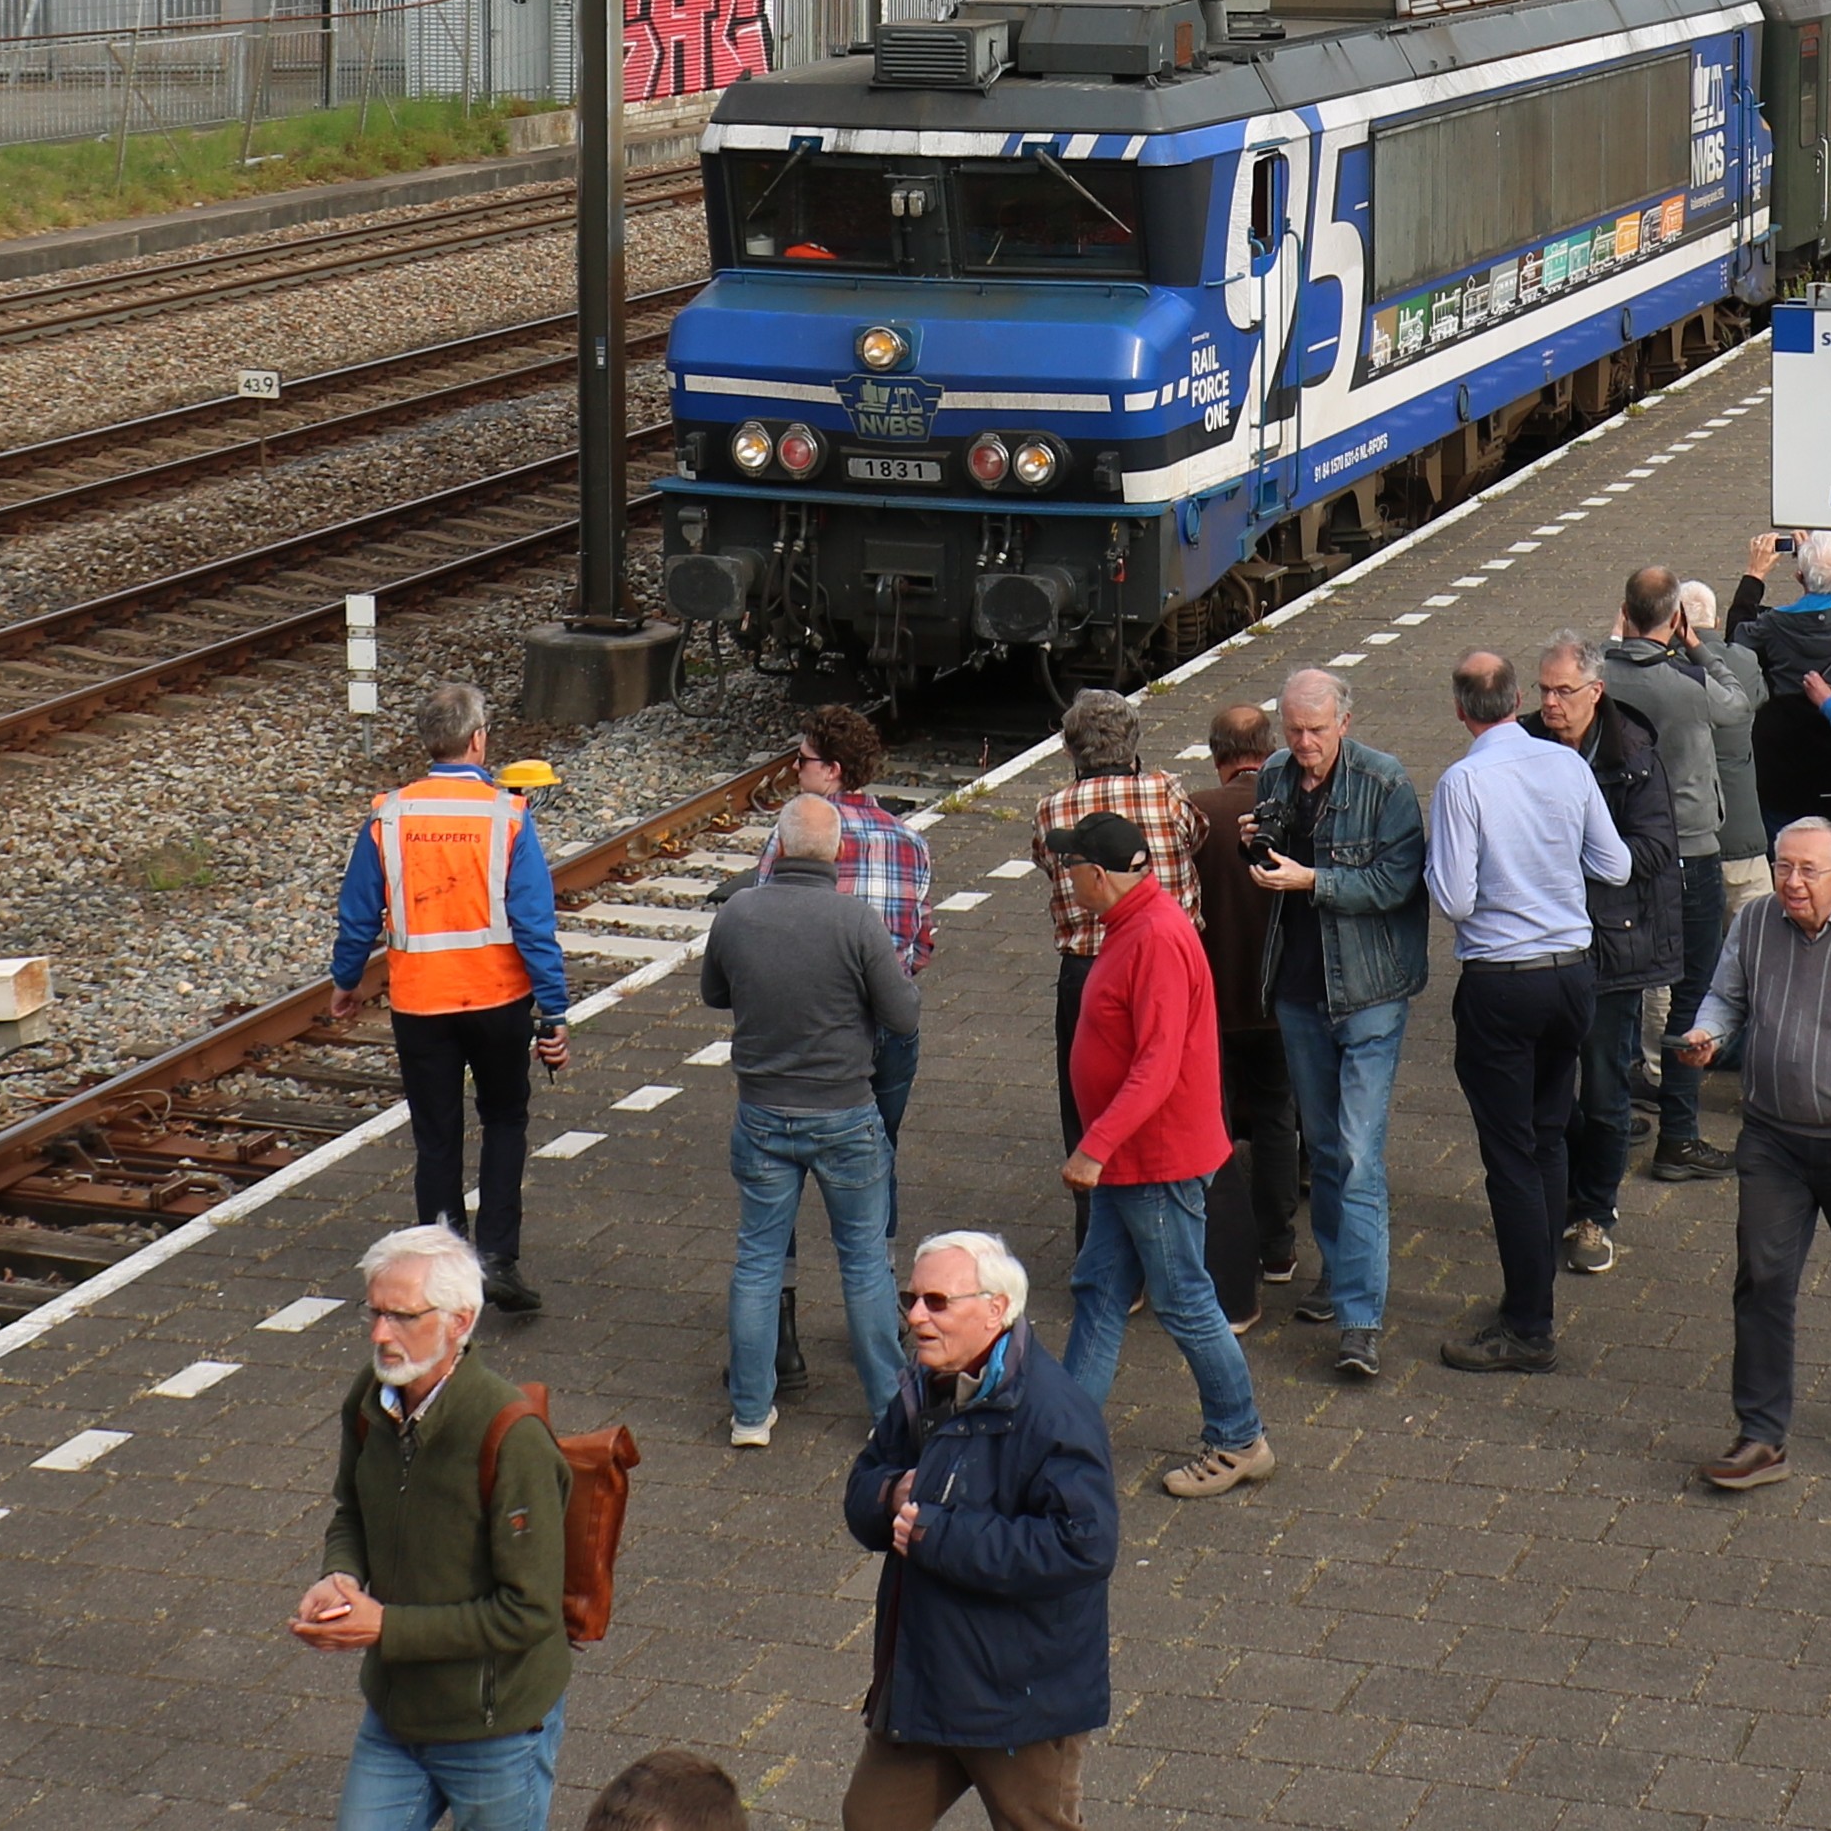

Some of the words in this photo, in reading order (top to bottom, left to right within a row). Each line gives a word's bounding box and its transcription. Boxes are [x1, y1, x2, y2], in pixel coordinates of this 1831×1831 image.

[1690, 130, 1726, 190] NVBS
[1192, 344, 1220, 378] RAIL
[243, 376, 274, 393] 43.9
[1192, 369, 1230, 408] FORCE
[858, 413, 926, 437] NVBS
[1204, 399, 1230, 432] ONE
[865, 460, 924, 479] 1831
[406, 833, 481, 843] RAILEXPERTS
